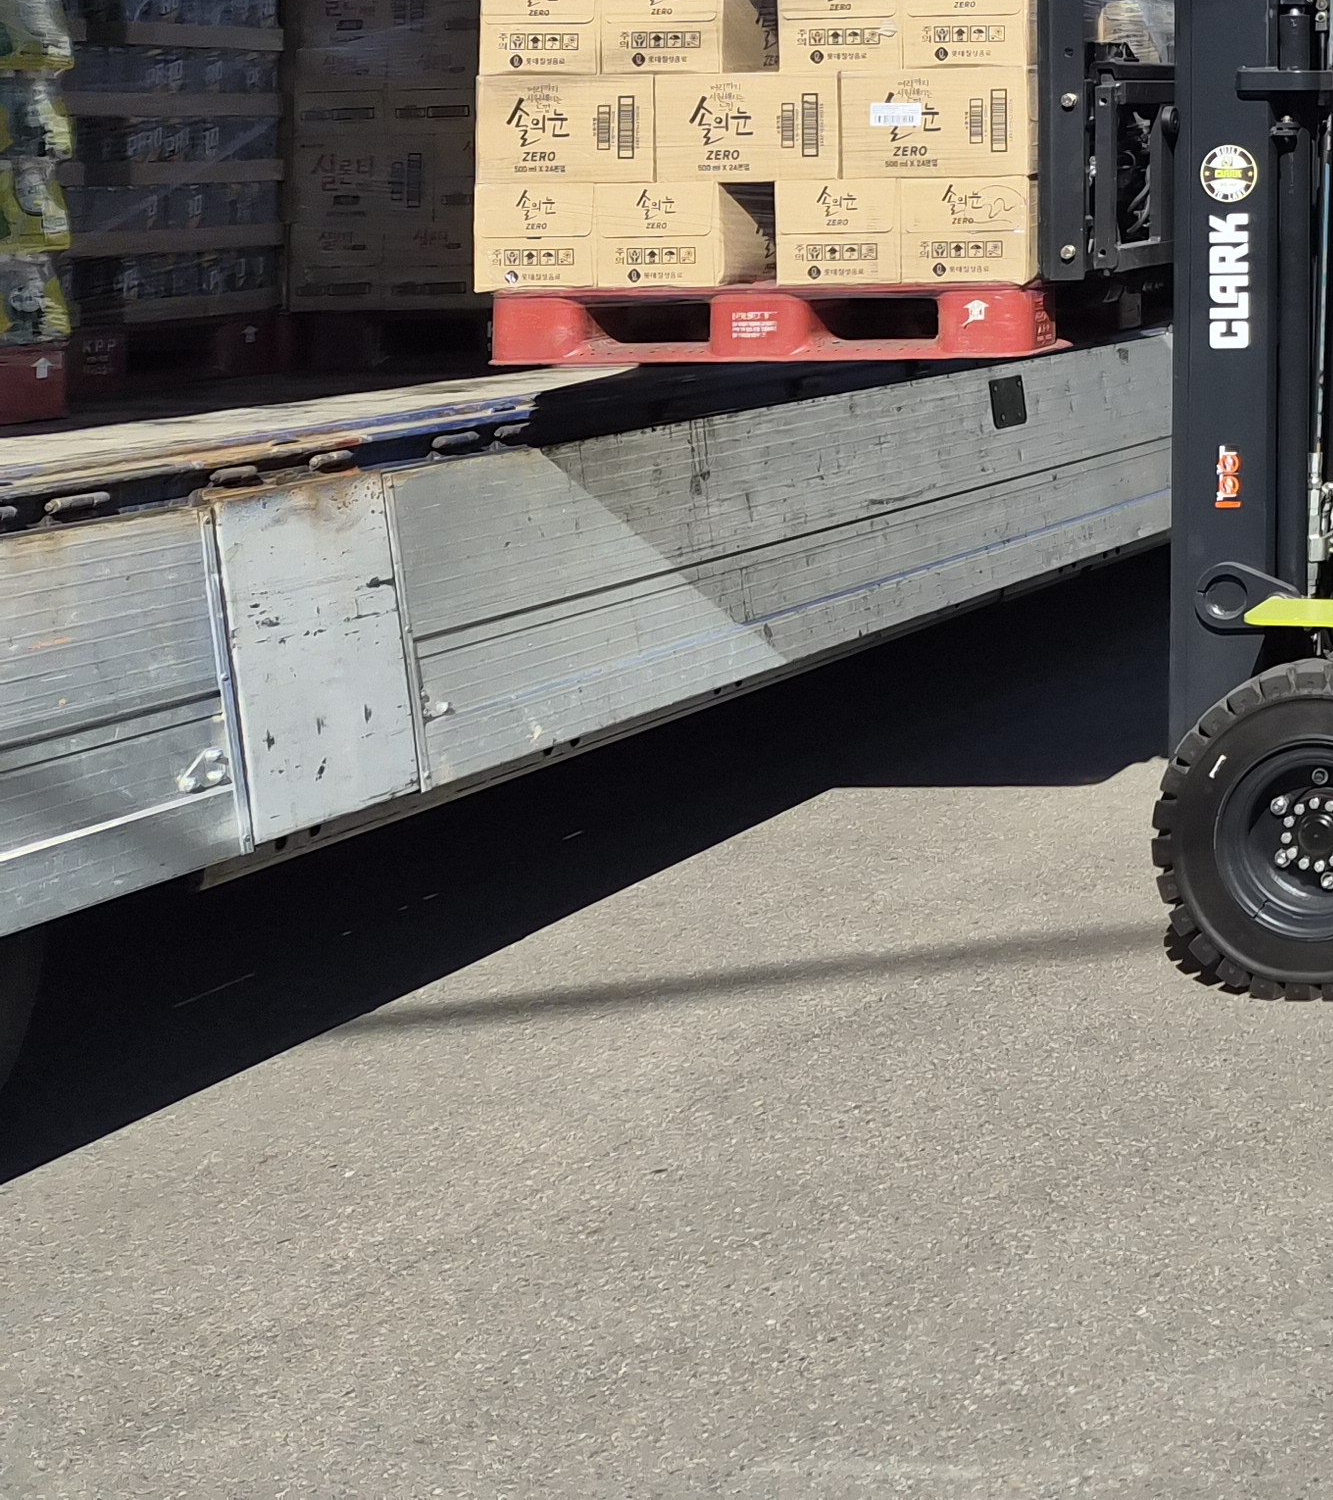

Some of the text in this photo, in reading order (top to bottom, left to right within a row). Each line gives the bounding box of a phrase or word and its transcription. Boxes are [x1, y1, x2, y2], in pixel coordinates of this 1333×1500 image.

[506, 97, 570, 147] 솔의눈
[689, 96, 754, 146] 솔의눈
[523, 152, 555, 162] ZERO
[706, 150, 740, 160] ZERO
[893, 146, 927, 156] ZERO
[516, 190, 556, 220] 솔의눈
[636, 189, 676, 220] 솔의눈
[817, 186, 858, 216] 솔의눈
[942, 184, 982, 215] 솔의눈
[1208, 212, 1250, 349] CLARK
[82, 339, 116, 354] KPP
